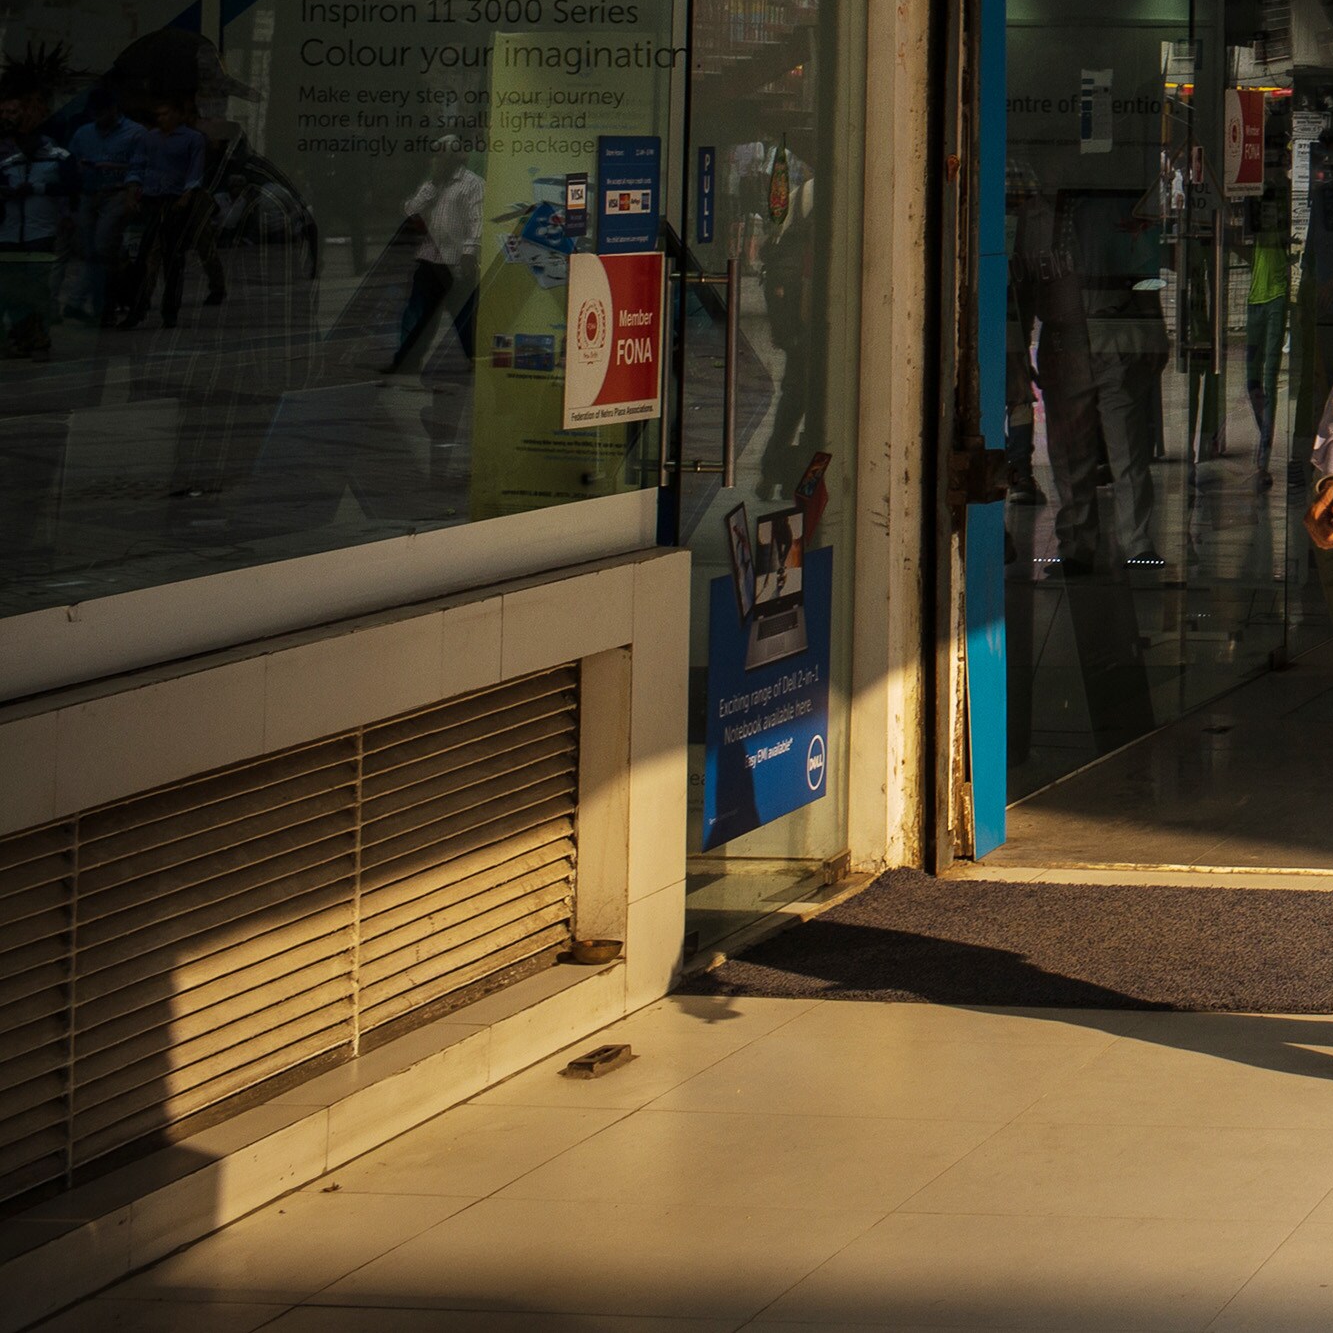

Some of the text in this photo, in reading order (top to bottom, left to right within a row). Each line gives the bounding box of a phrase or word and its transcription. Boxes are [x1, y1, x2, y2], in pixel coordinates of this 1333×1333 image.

[427, 0, 454, 24] 11
[467, 0, 543, 24] 3000
[301, 39, 411, 68] Colour
[420, 47, 493, 75] your
[300, 86, 625, 109] Make every step on your journey
[1058, 94, 1079, 113] of
[298, 114, 350, 128] more
[357, 110, 389, 128] fun
[396, 112, 413, 128] in
[419, 114, 431, 128] a
[500, 110, 543, 133] light
[550, 111, 586, 129] and
[297, 134, 599, 157] amazingly affordable package.
[703, 153, 711, 238] PULL
[619, 309, 653, 327] Member
[616, 337, 653, 365] FONA
[719, 693, 749, 718] Exciting
[724, 722, 762, 746] Notebook
